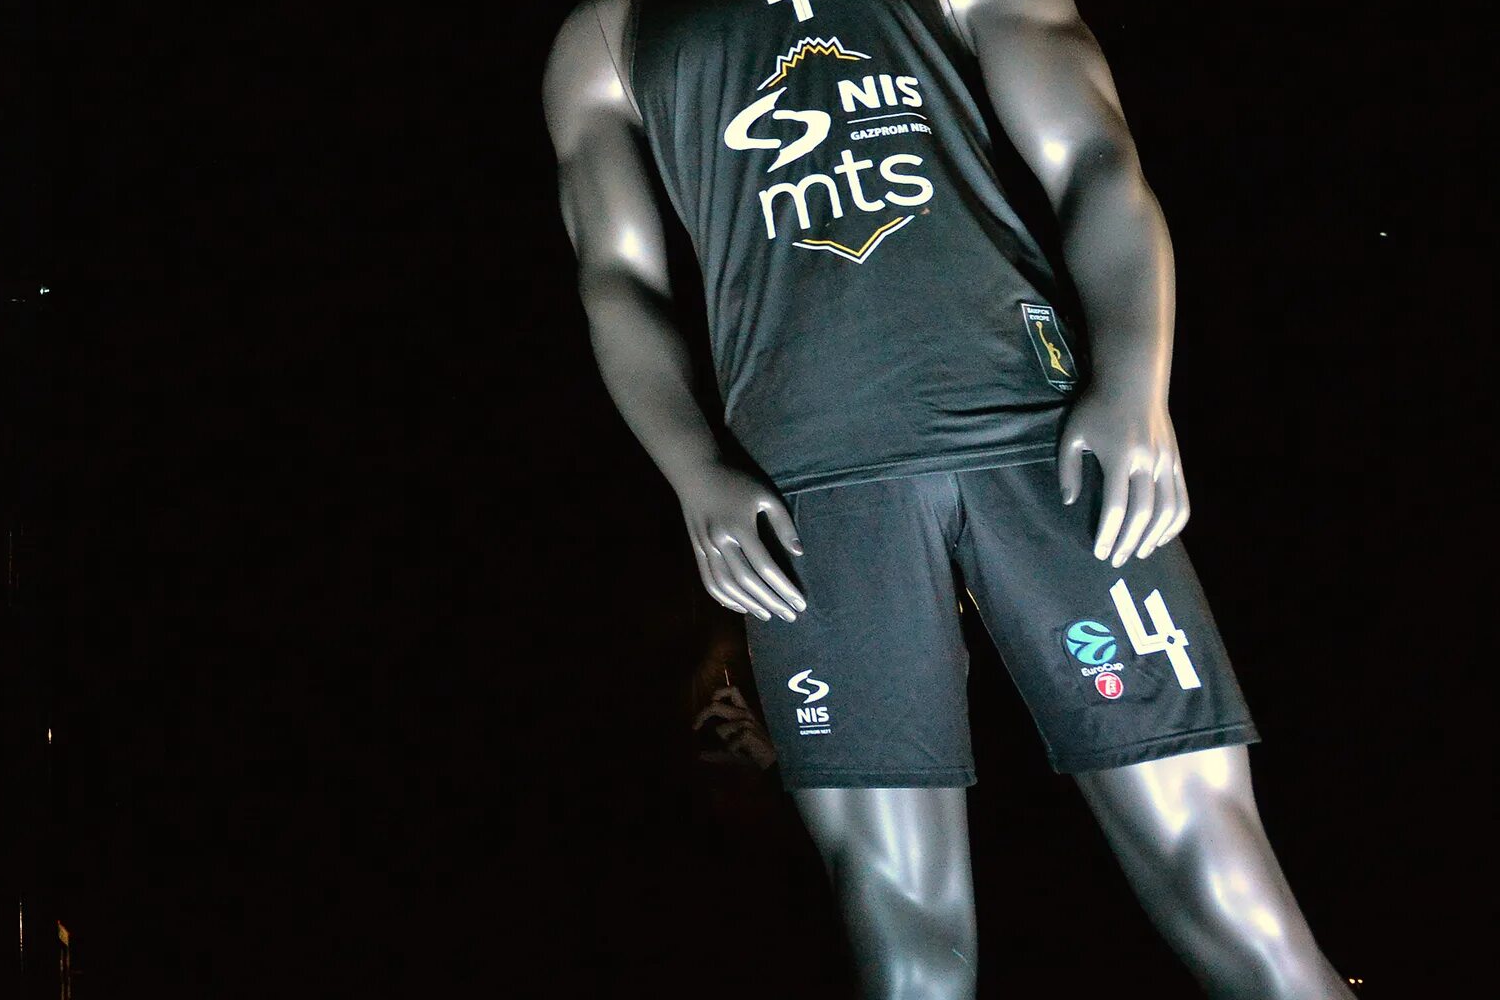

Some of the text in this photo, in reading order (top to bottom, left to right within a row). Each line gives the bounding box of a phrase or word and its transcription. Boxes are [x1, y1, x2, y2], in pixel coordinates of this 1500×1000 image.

[838, 74, 923, 112] NIS
[850, 124, 909, 141] GAZPROM
[759, 149, 934, 239] mts
[1109, 578, 1201, 690] 4
[1081, 662, 1124, 677] EuroCup
[796, 706, 830, 724] NIS
